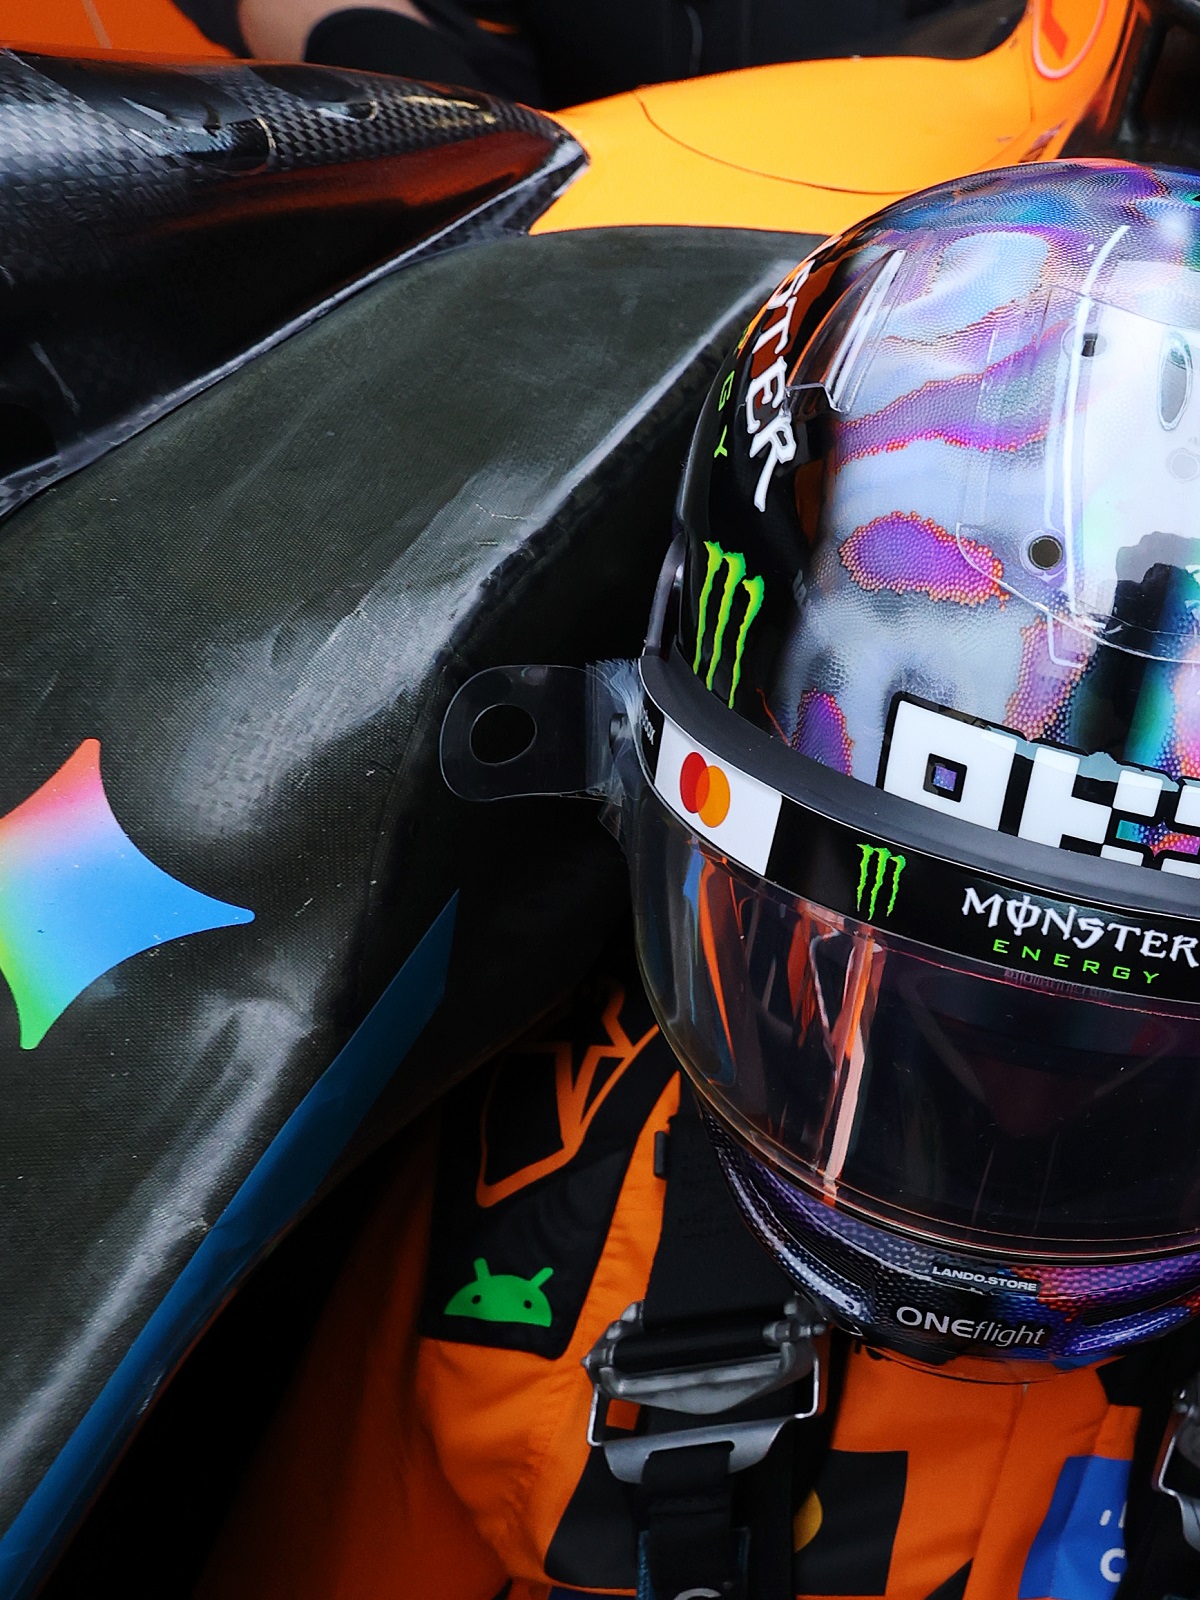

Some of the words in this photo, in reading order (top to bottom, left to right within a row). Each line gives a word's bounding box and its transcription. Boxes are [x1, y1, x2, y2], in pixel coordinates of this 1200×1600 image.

[961, 887, 1200, 969] MONSTER
[992, 938, 1160, 985] ENERGY
[931, 1265, 1038, 1292] LANDO.STORE
[896, 1305, 1046, 1347] ONEflight
